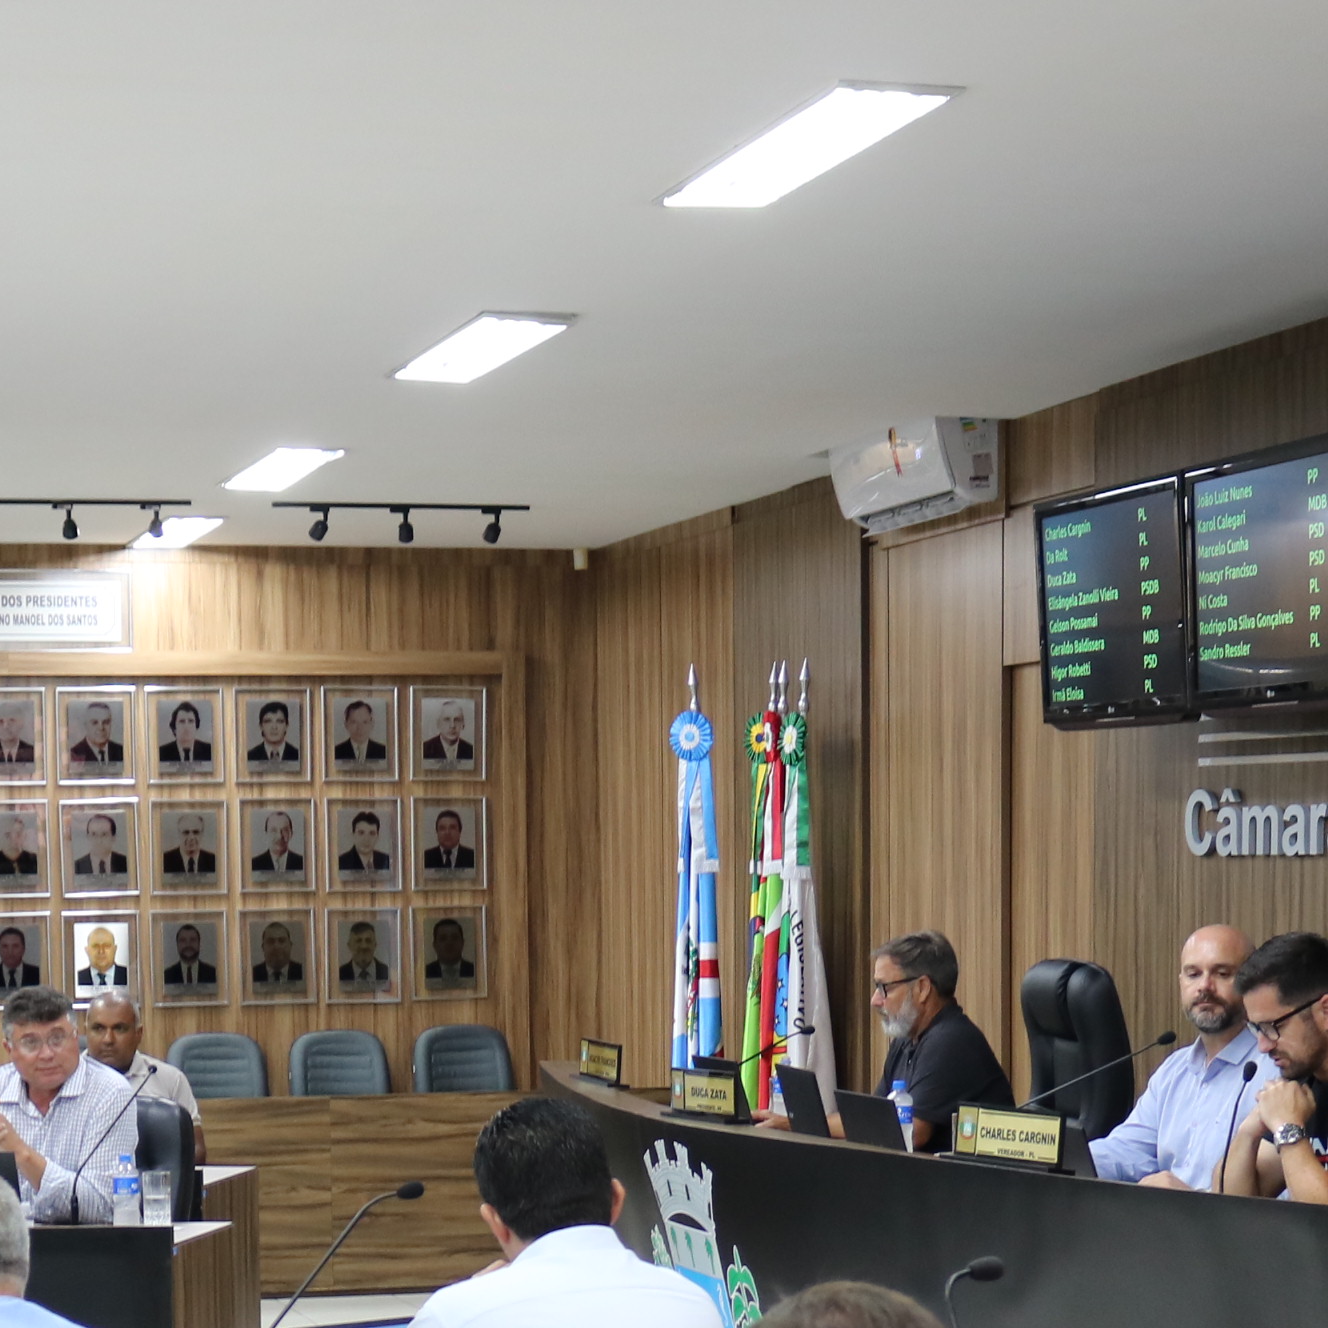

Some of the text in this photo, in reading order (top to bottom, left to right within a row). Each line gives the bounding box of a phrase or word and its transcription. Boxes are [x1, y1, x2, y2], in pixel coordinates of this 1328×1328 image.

[1307, 467, 1319, 485] PP
[1197, 485, 1253, 509] João Luiz Nunes
[1308, 494, 1327, 512] MDB
[1137, 507, 1147, 522] PL
[1198, 510, 1246, 534] Karol Calegari
[1045, 519, 1091, 541] Charles Cargnin
[1309, 522, 1324, 540] PSD
[1138, 532, 1149, 546] PL
[1198, 536, 1249, 560] Marcelo Cunha
[1140, 556, 1150, 571] PP
[1309, 550, 1325, 566] PSD
[1047, 571, 1077, 587] Duca Zata
[1198, 562, 1258, 585] Moacyr Francisco
[1141, 579, 1160, 595] PSDB
[1309, 578, 1320, 594] PL
[1, 594, 23, 607] DOS
[25, 594, 98, 607] PRESIDENTES
[1048, 592, 1078, 611] Elisângela
[1100, 586, 1119, 602] Vieira
[1199, 593, 1228, 610] Ni Costa
[12, 613, 45, 626] MANOEL
[48, 613, 64, 625] DOS
[66, 613, 98, 625] SANTOS
[1142, 605, 1152, 620] PP
[1310, 605, 1321, 621] PP
[1049, 613, 1098, 634] Gelson Possamai
[1199, 608, 1294, 637] Rodrigo Da Silva Gonçalves
[1143, 629, 1160, 645] MDB
[1310, 632, 1321, 648] PL
[1050, 637, 1105, 657] Geraldo Baldissera
[1199, 640, 1251, 662] Sandro Ressler
[1144, 654, 1158, 669] PSD
[1052, 661, 1091, 682] Higor Robetti
[1066, 686, 1084, 702] Eloisa
[1144, 678, 1154, 694] PL
[691, 1086, 727, 1101] DUCA ZATA
[980, 1126, 1056, 1145] CHARLES CARGNIN
[997, 1148, 1025, 1157] VEREADOR
